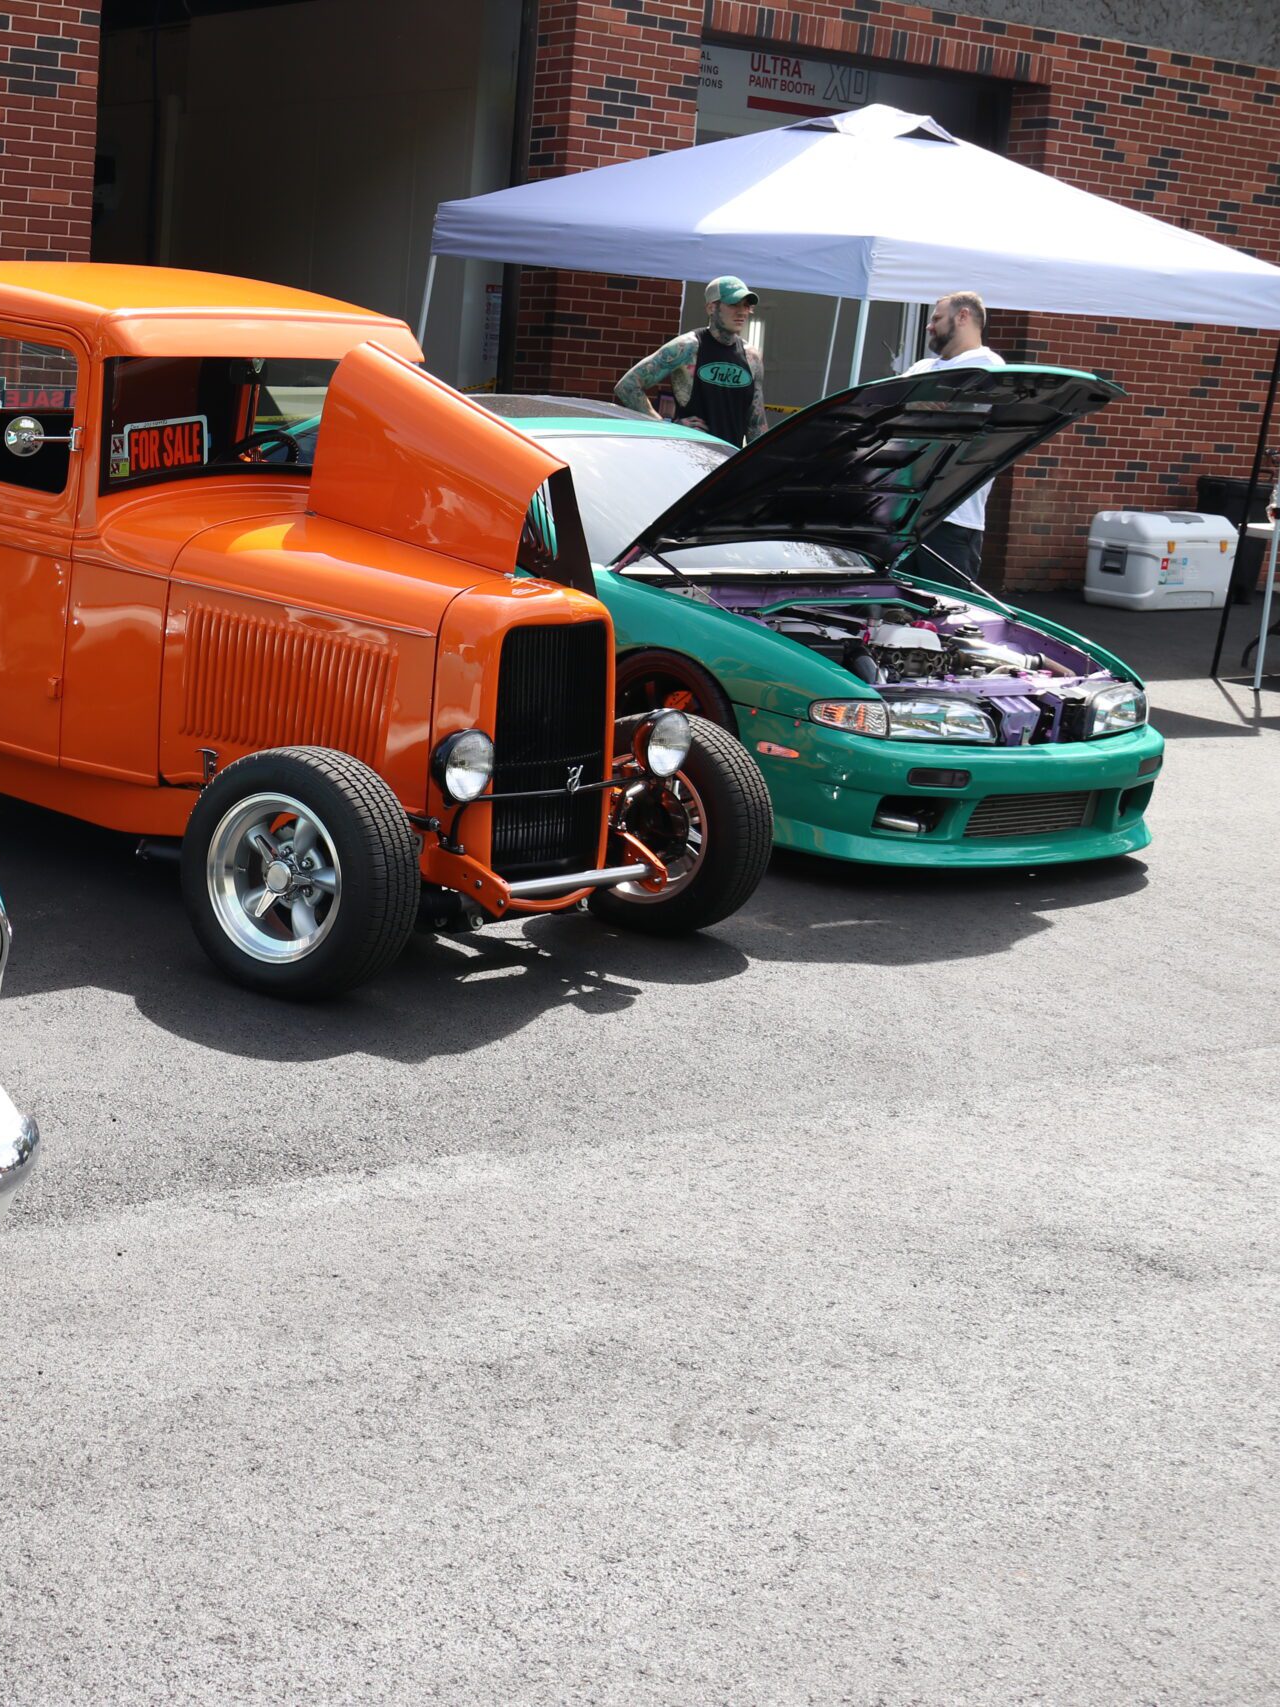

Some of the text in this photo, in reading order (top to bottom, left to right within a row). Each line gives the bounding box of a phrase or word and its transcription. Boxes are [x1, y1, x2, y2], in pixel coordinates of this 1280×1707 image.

[750, 52, 802, 79] ULTRA
[748, 75, 816, 96] PAINT BOOTH
[710, 366, 741, 384] Ink'd
[131, 429, 160, 470] FOR
[163, 423, 200, 467] SALE
